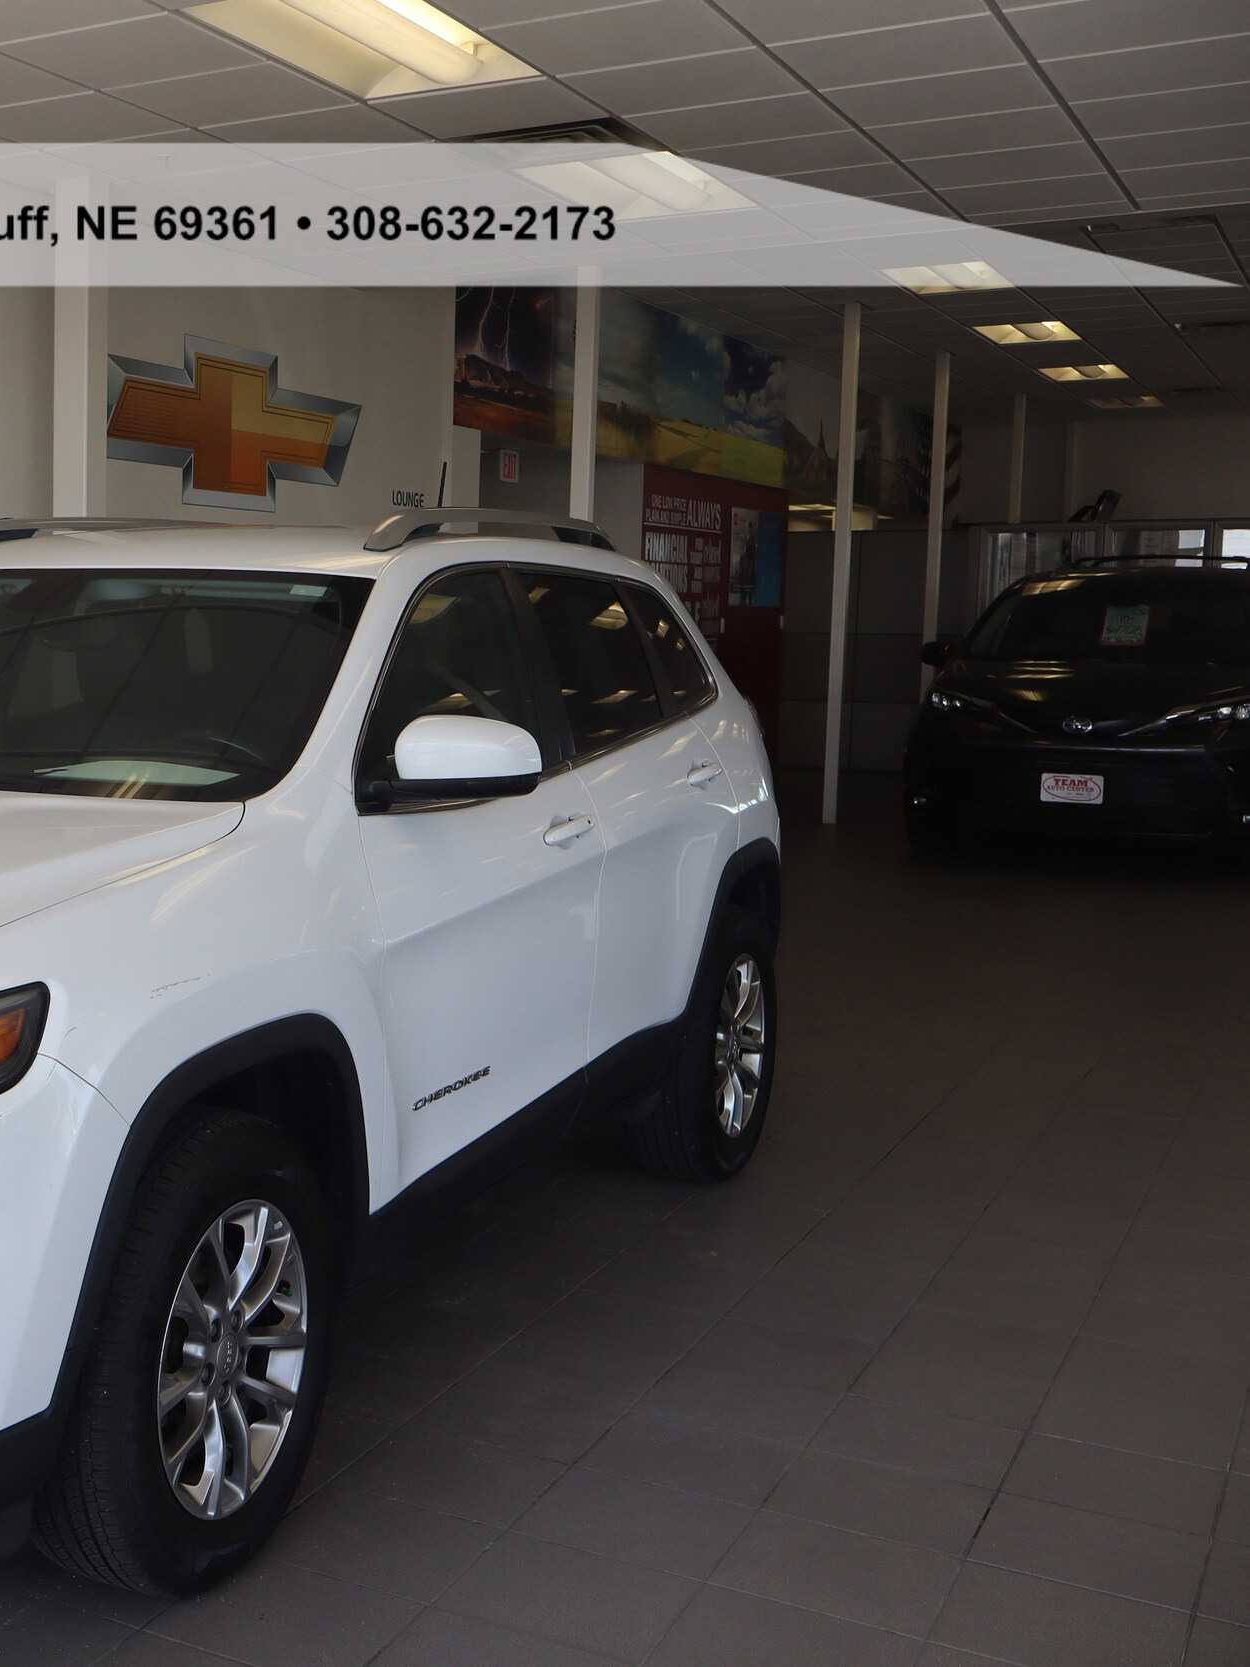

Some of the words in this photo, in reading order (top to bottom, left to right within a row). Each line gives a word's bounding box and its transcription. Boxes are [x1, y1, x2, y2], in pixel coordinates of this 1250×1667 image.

[392, 490, 424, 508] LOUNGE
[652, 494, 662, 508] ONE
[662, 496, 673, 509] LOW
[673, 497, 687, 512] PRICE
[645, 508, 659, 523] PLAIN
[659, 510, 670, 523] AND
[670, 511, 686, 526] SIMPLE
[687, 499, 721, 530] ALWAYS
[645, 531, 688, 564] FINANCIAL
[1053, 778, 1089, 787] TEAM
[412, 1065, 491, 1112] CHEROKEE
